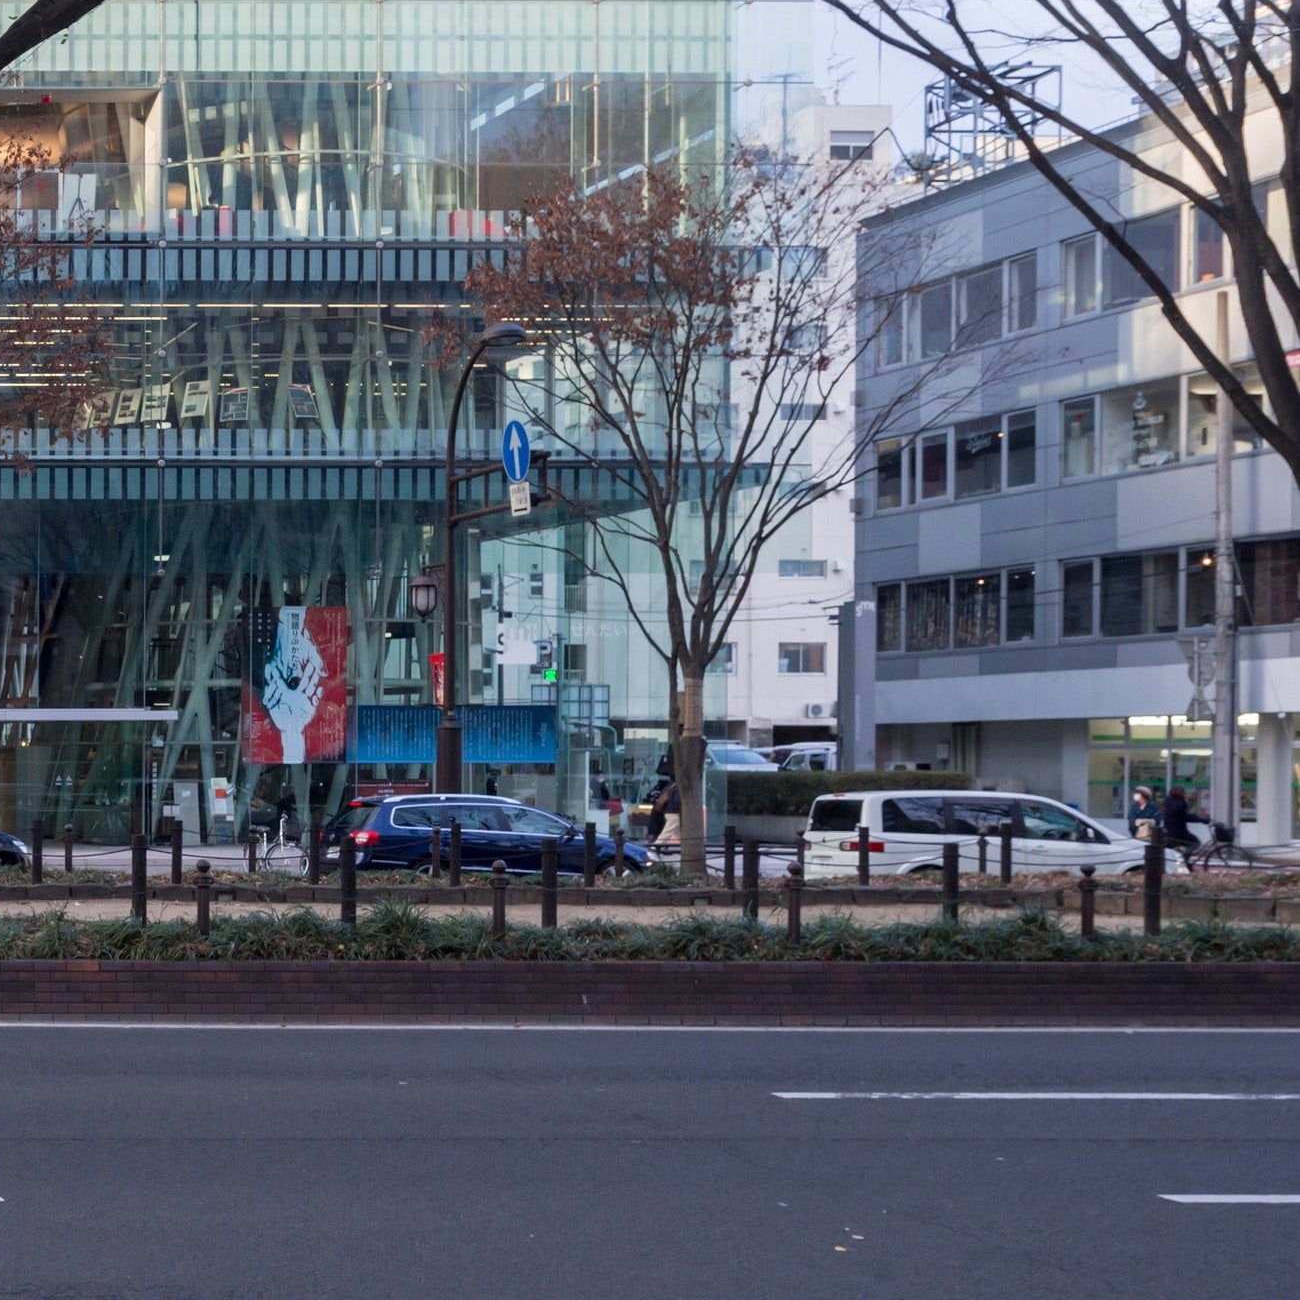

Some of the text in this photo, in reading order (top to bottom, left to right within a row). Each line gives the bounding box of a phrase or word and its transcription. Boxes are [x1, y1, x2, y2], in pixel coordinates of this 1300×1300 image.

[290, 612, 300, 671] 物語りのかたち
